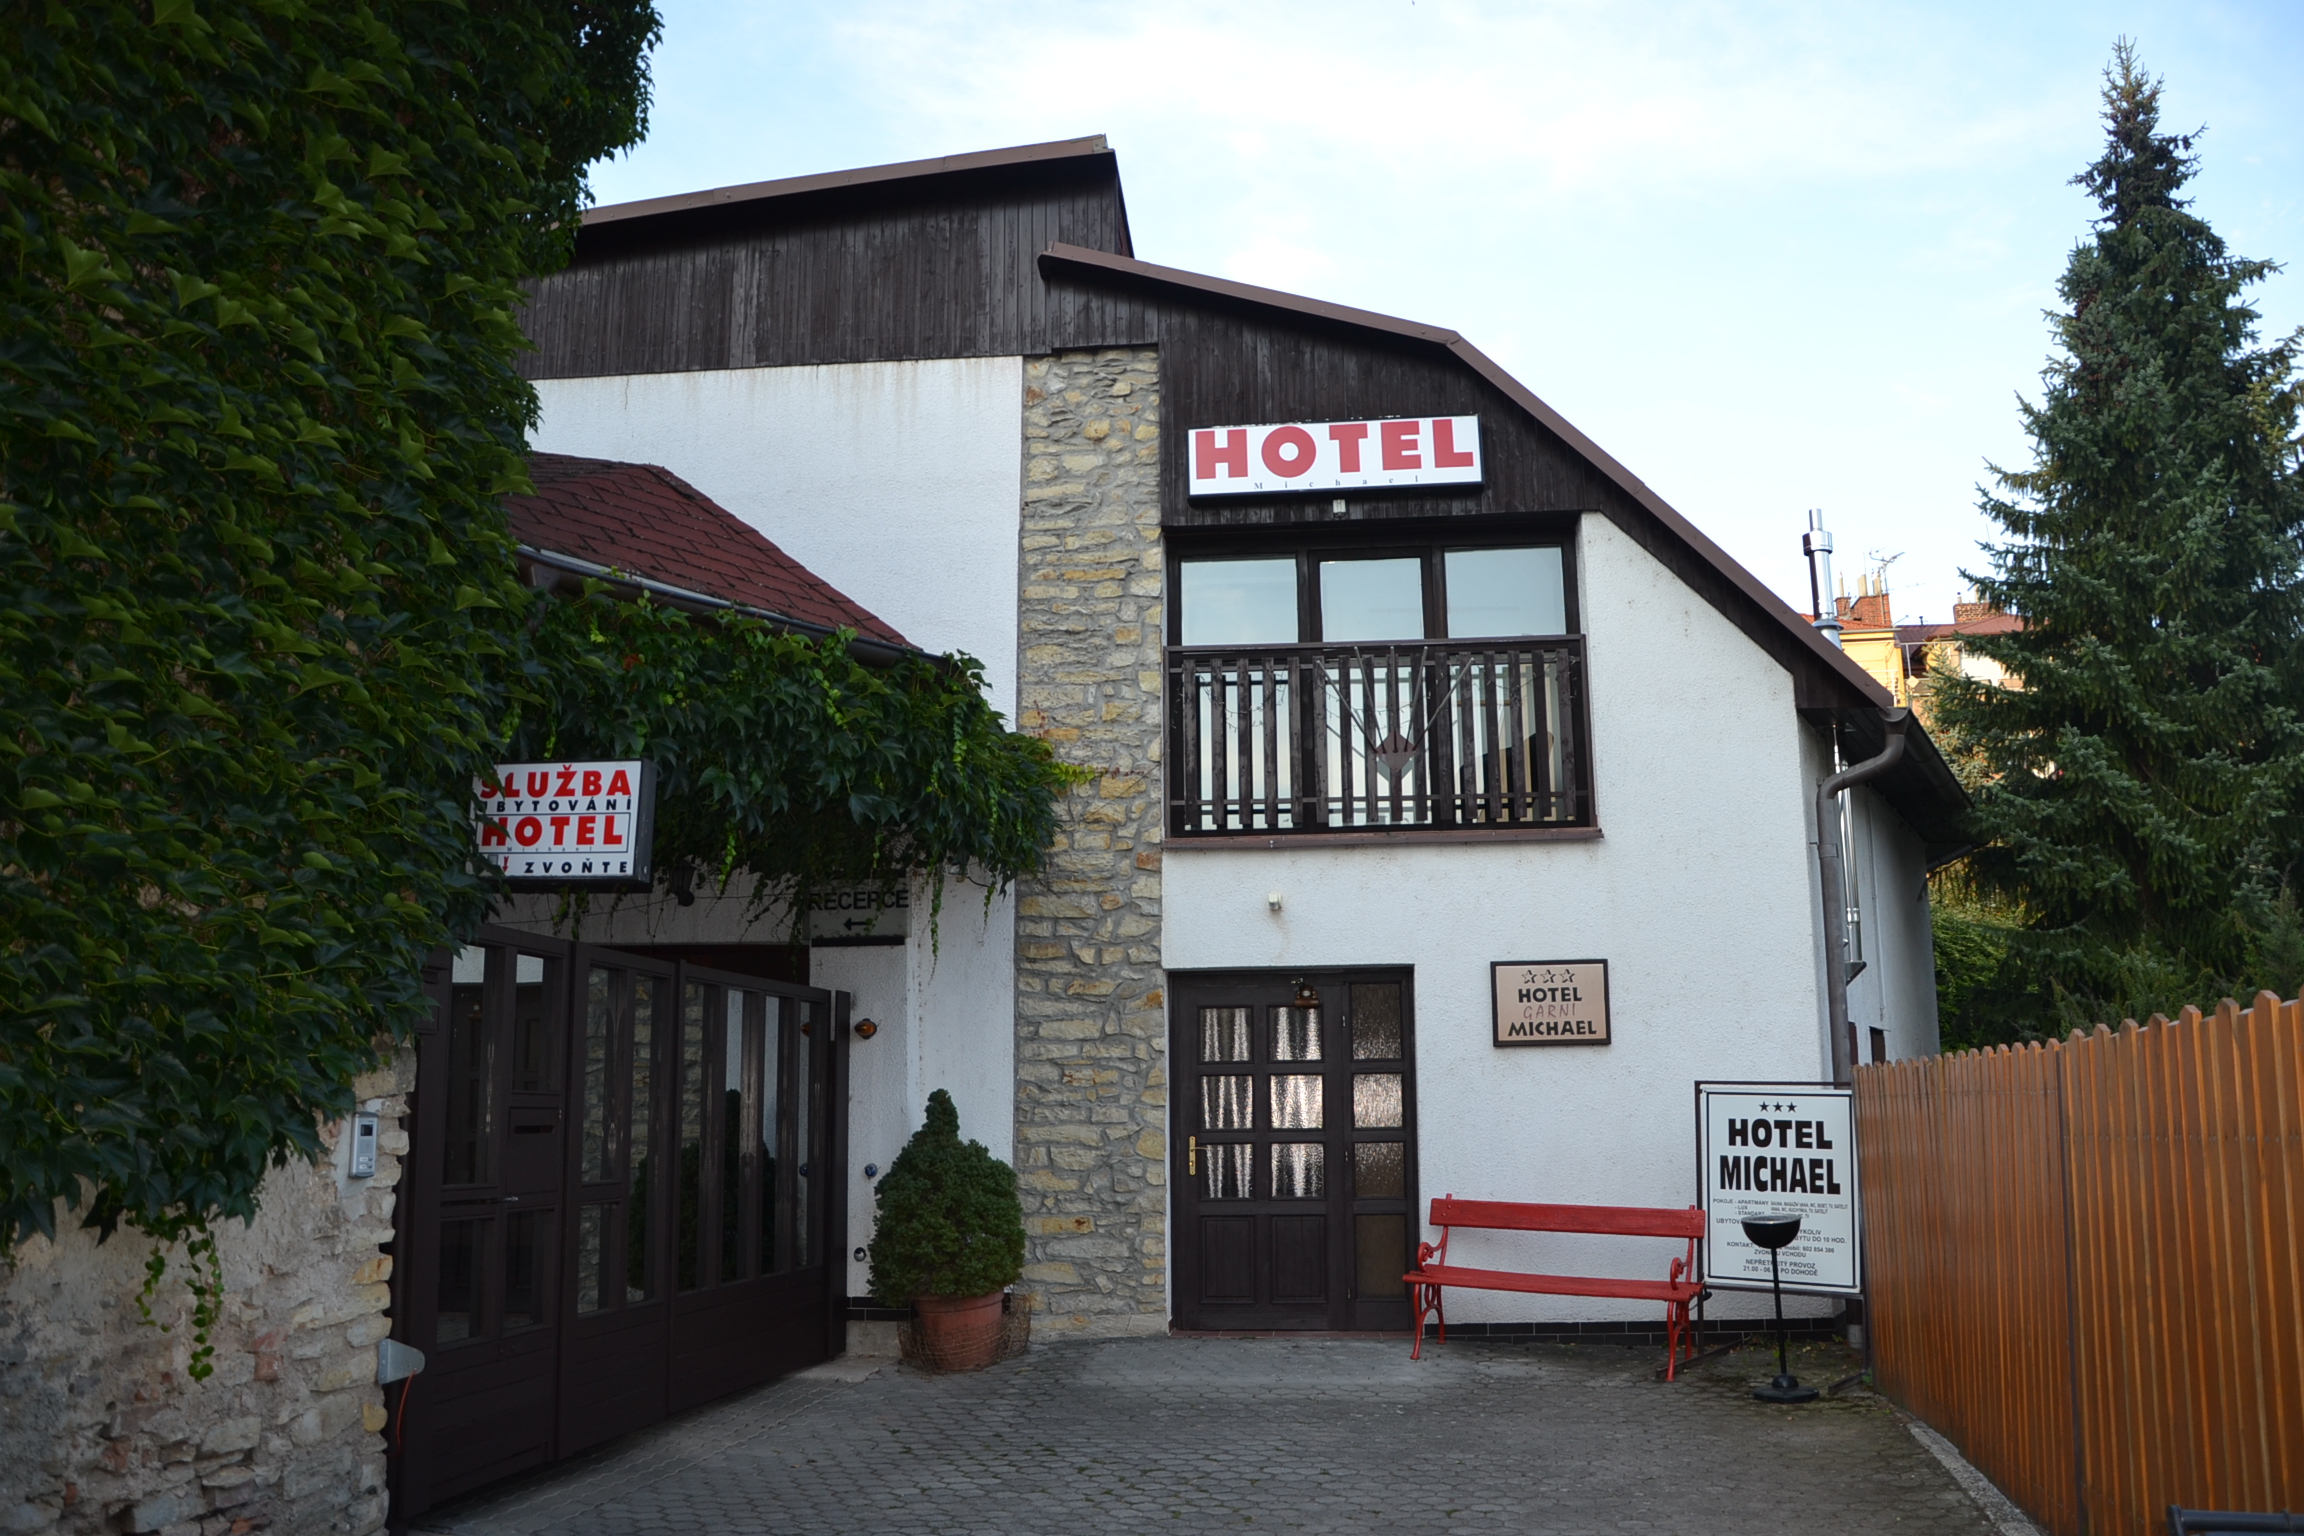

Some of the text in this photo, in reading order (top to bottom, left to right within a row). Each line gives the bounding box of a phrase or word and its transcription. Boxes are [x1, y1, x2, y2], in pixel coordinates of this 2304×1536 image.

[1195, 418, 1475, 480] HOTEL
[1253, 475, 1419, 491] Michael
[480, 763, 632, 799] SLUŽBA
[481, 814, 624, 848] HOTEL
[523, 857, 628, 874] ZVOŇTE
[808, 889, 910, 911] RECEPCE
[1518, 986, 1583, 1004] HOTEL
[1523, 1003, 1576, 1021] GARNI
[1507, 1020, 1598, 1037] MICHAEL
[1728, 1118, 1833, 1150] HOTEL
[1719, 1155, 1842, 1195] MICHAEL
[1789, 1261, 1816, 1269] PROVOZ
